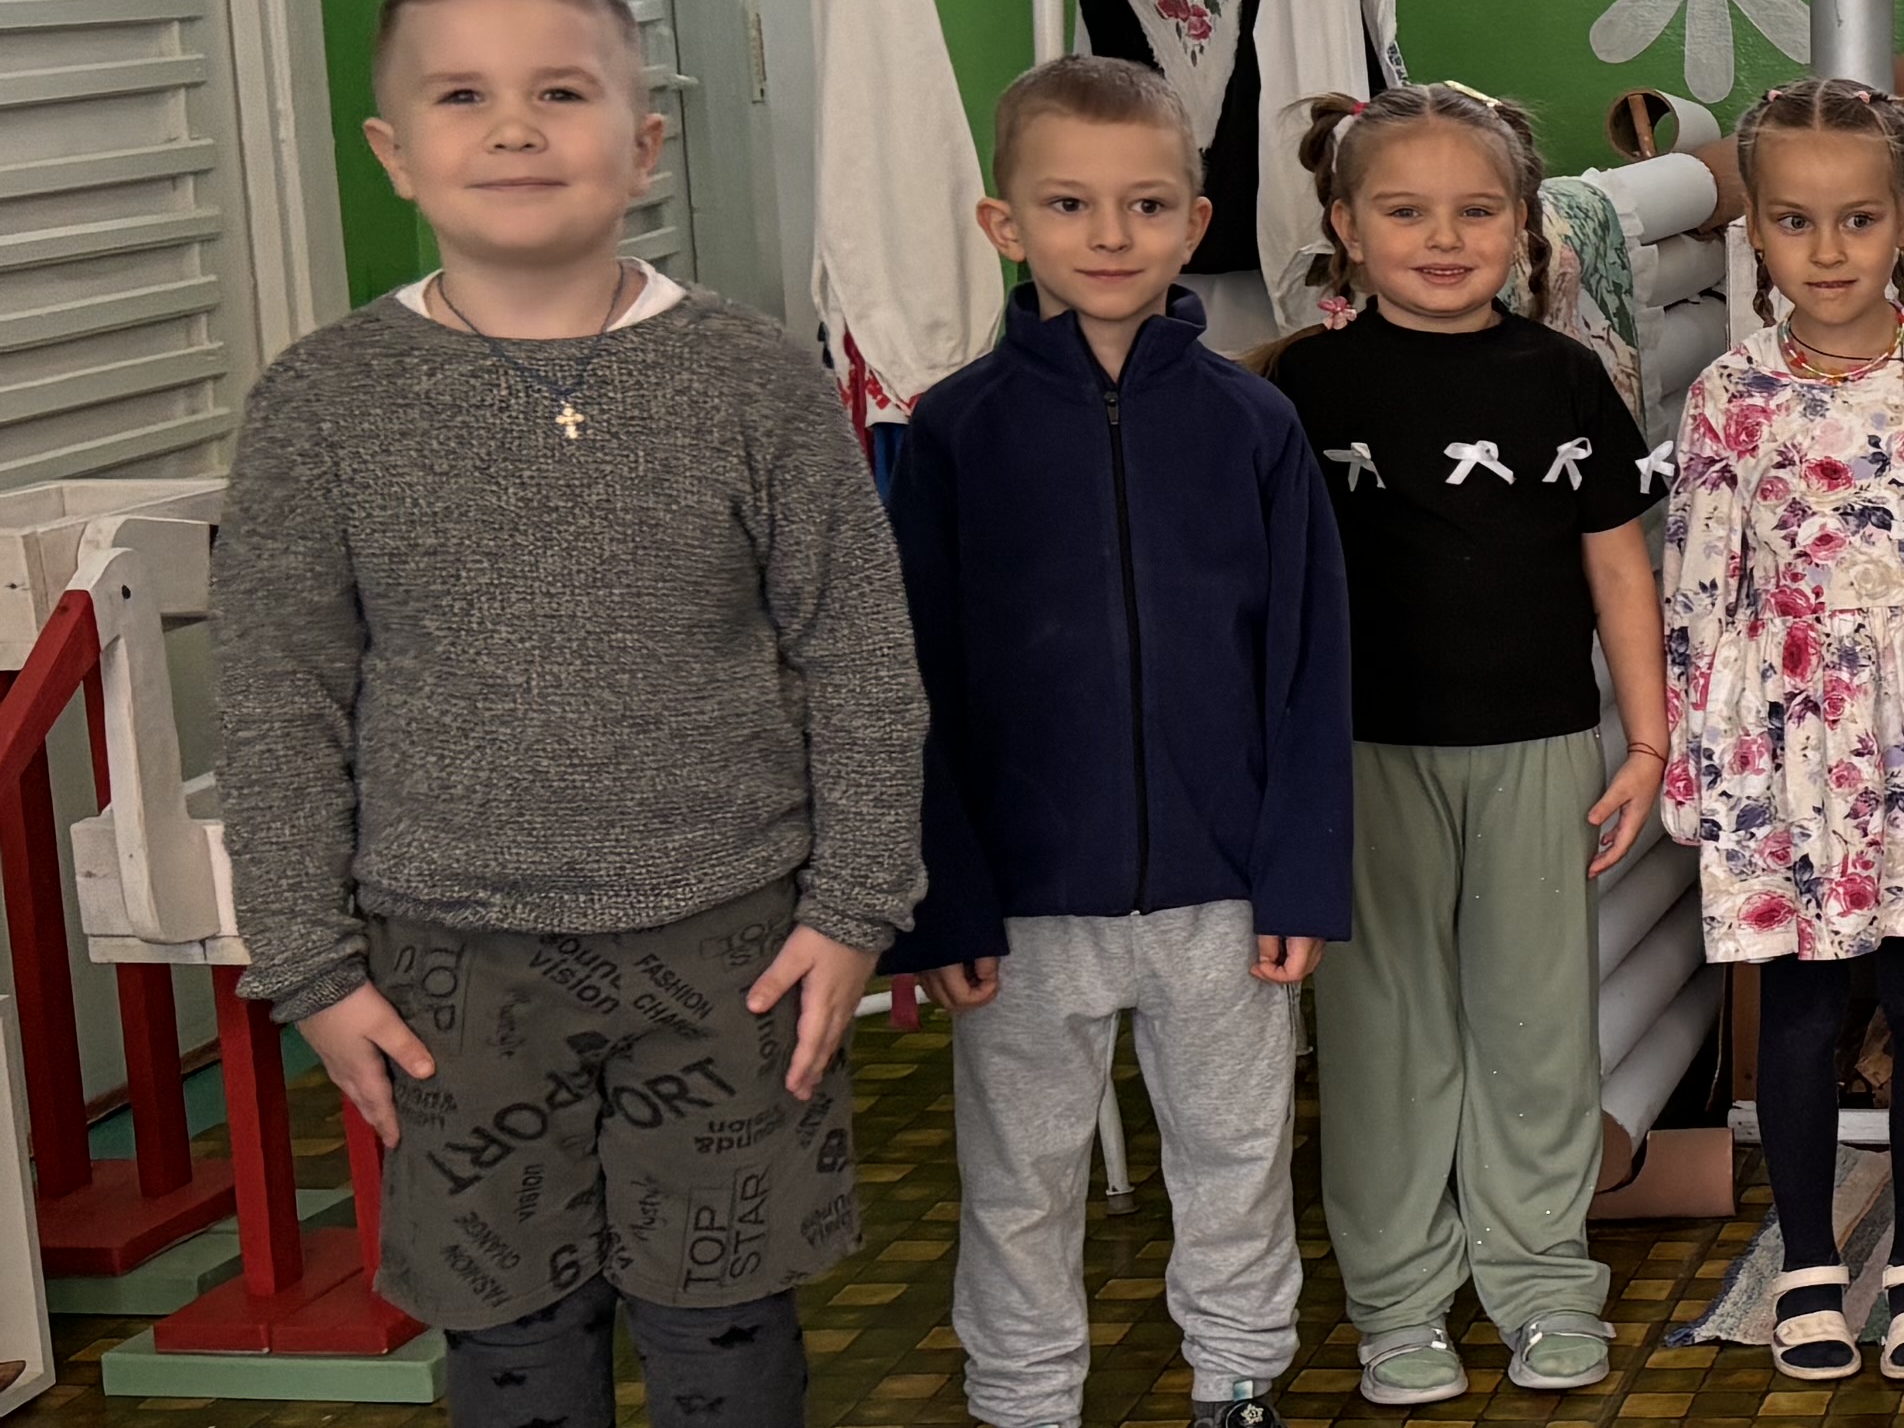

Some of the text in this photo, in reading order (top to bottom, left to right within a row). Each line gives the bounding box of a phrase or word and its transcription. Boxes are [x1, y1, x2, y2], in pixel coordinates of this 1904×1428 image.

[634, 953, 714, 1020] FASHION
[682, 1205, 728, 1293] TOP
[728, 1160, 773, 1280] STAR
